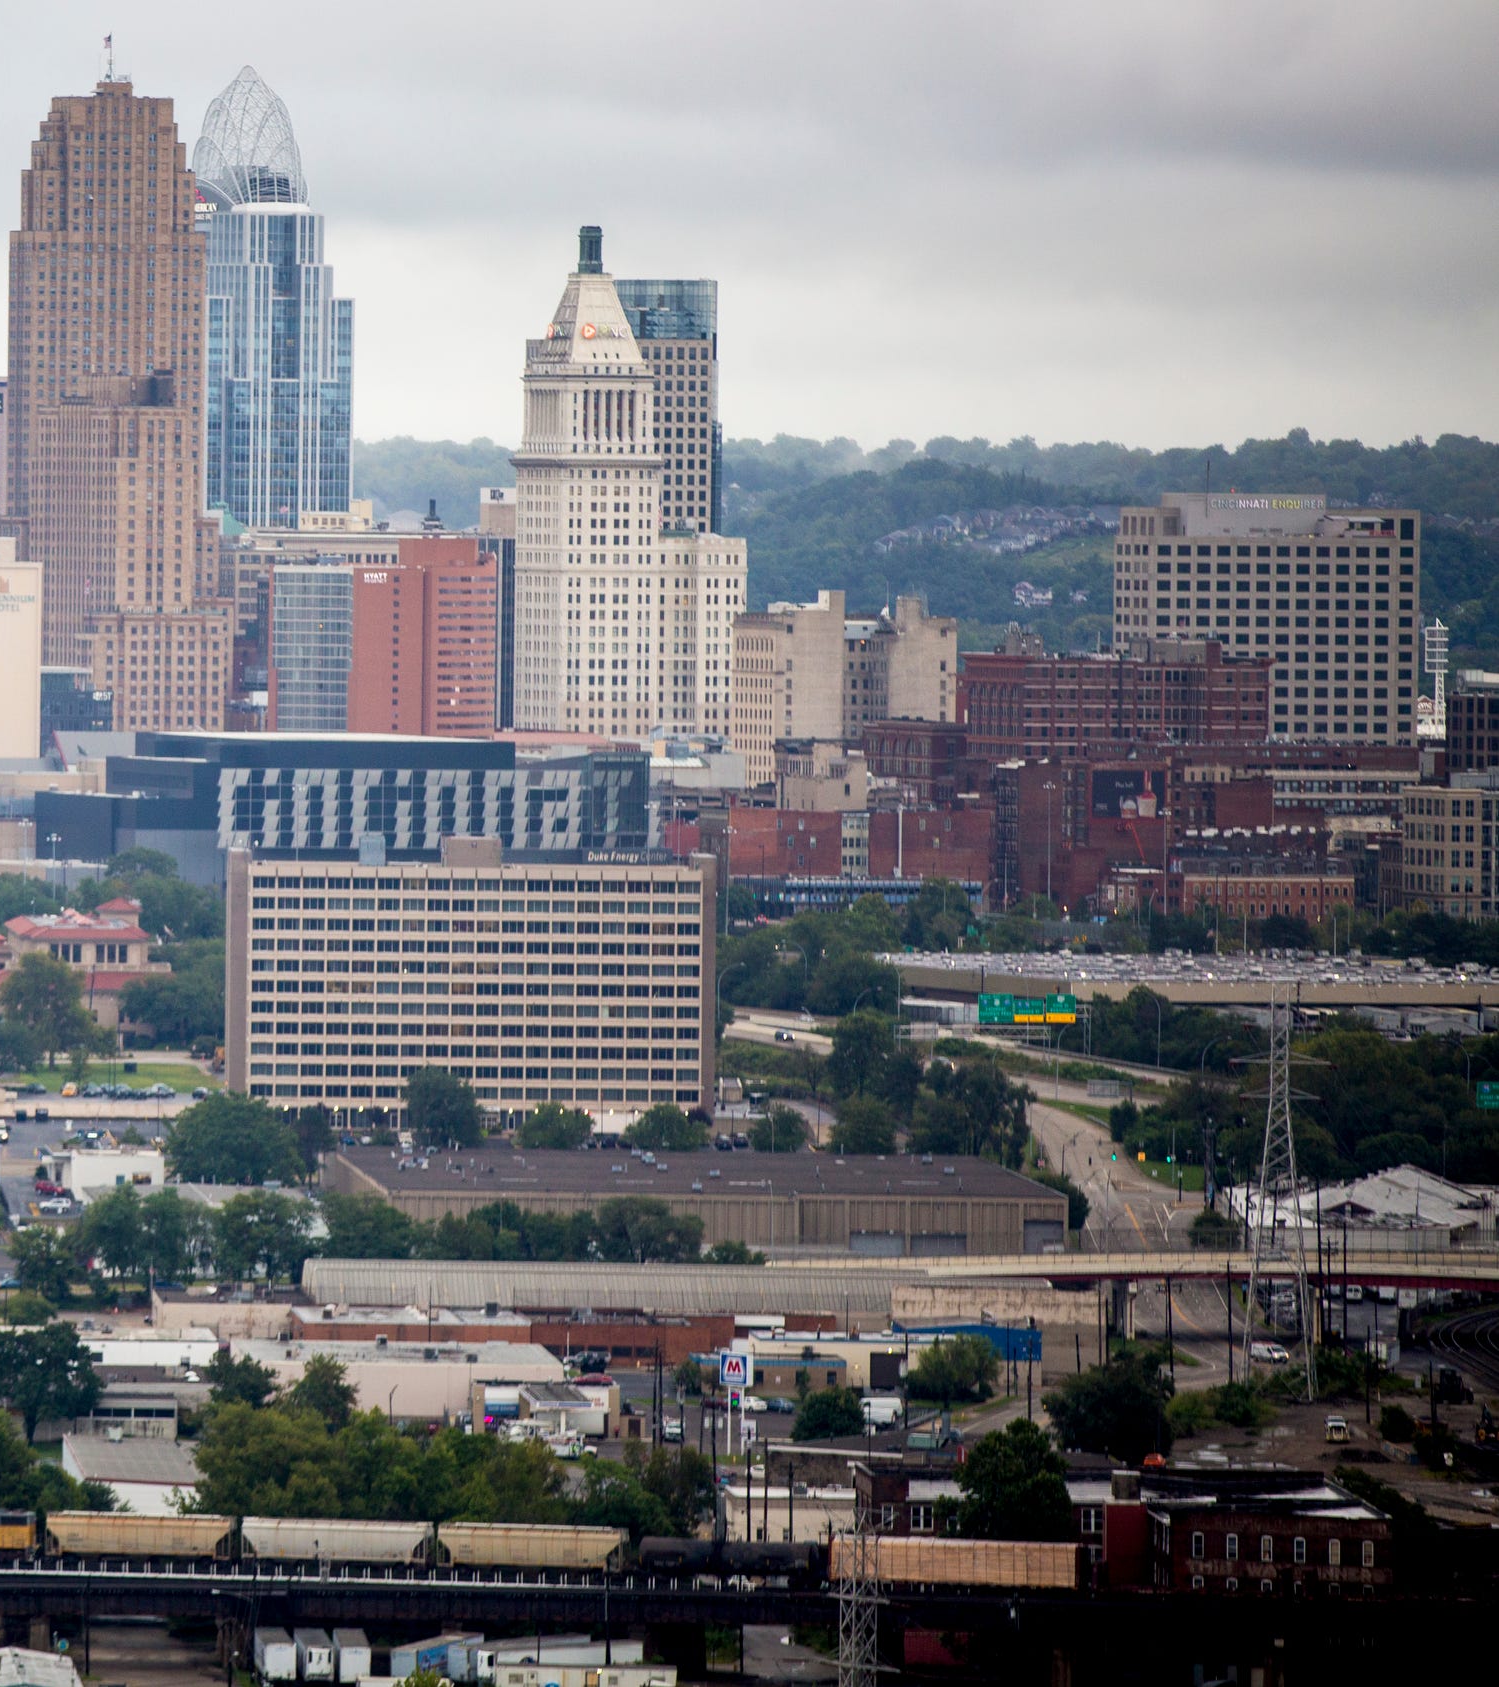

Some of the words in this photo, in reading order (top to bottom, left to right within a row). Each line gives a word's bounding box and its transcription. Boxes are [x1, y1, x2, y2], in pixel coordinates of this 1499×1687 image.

[1211, 499, 1269, 510] CINCINNATI
[1272, 499, 1324, 510] ENQUIRER
[363, 572, 388, 580] HYATT
[588, 850, 609, 862] Duke
[611, 850, 640, 864] Energy
